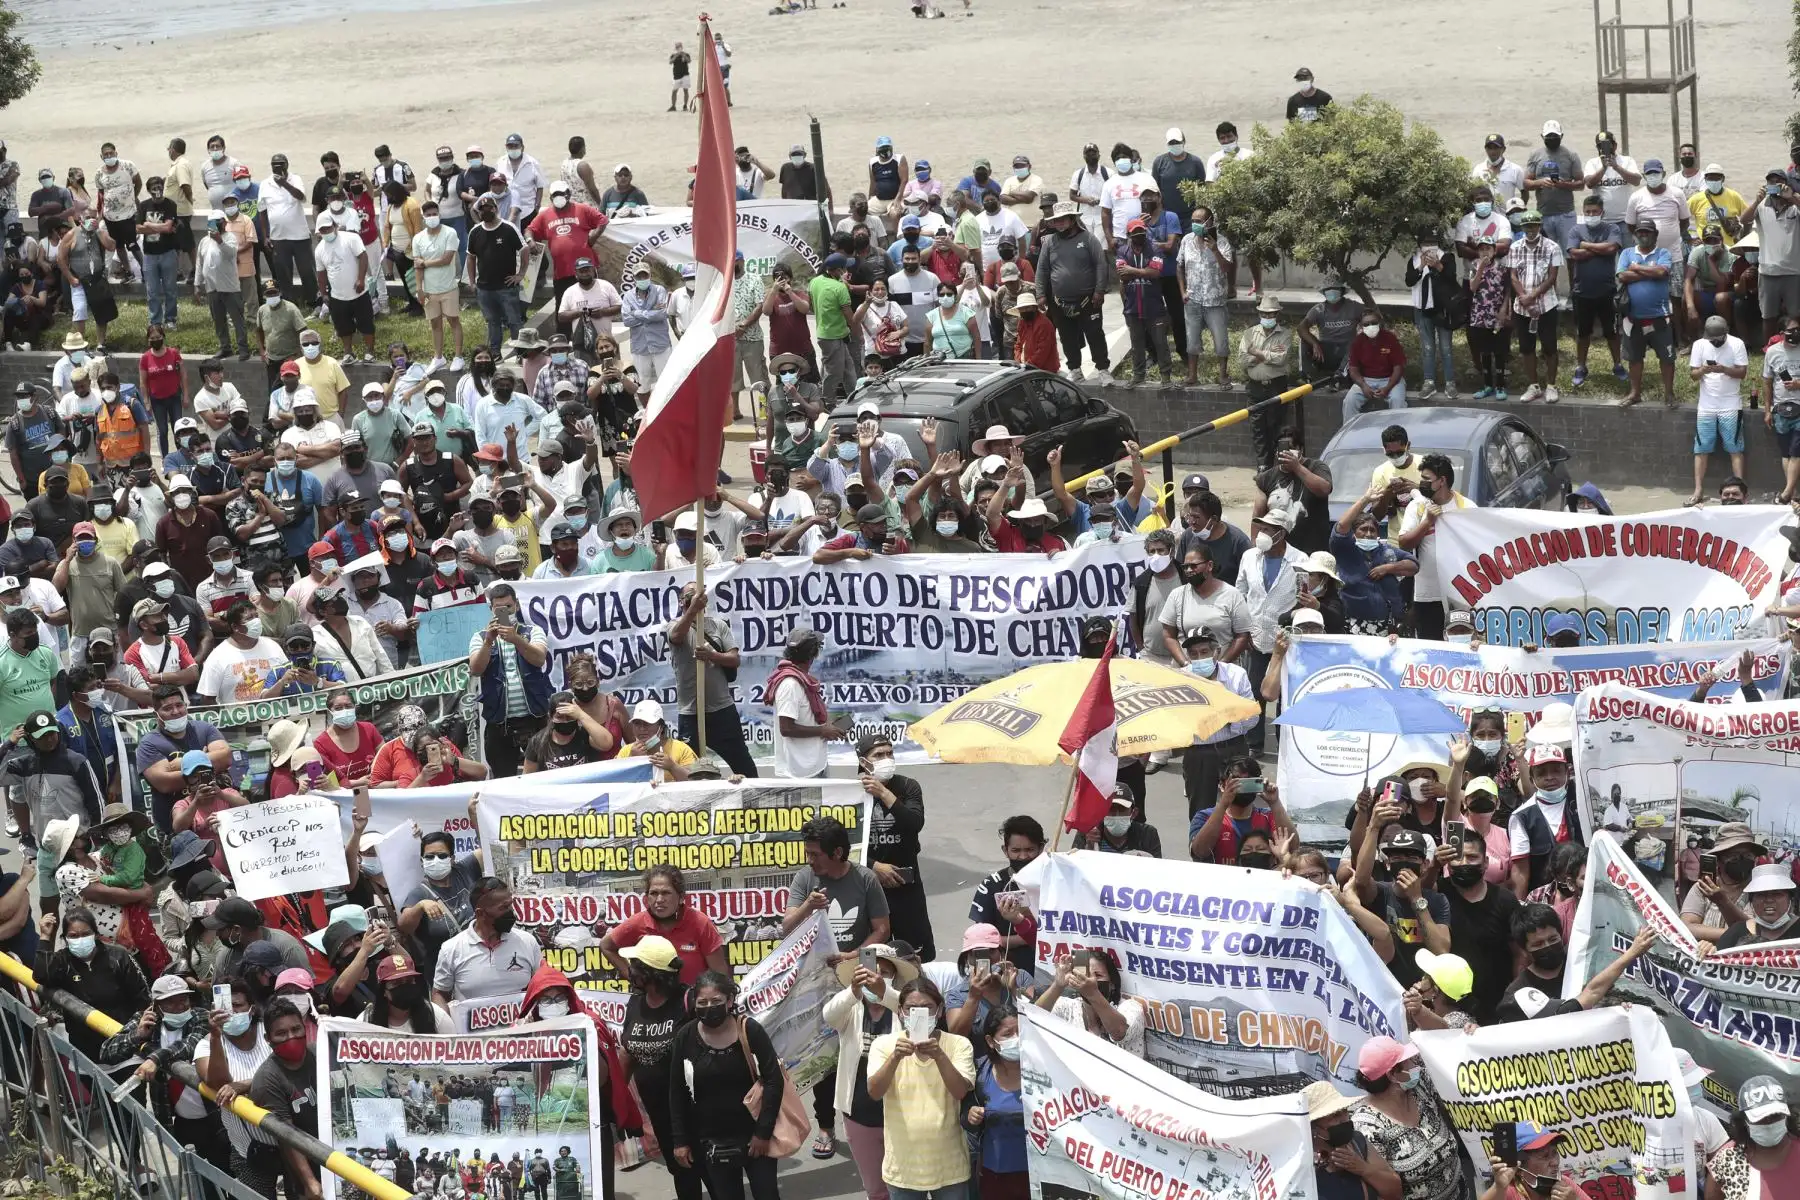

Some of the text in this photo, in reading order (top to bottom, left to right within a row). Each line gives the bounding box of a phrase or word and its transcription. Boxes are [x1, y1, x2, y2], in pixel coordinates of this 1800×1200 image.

[650, 231, 669, 248] DE
[1451, 523, 1773, 606] ASOCIACION DE COMERCIANTES
[517, 561, 1146, 641] SOCIACIÓ SINDICATO DE PESCADOR
[812, 611, 943, 651] PUERTO
[953, 617, 998, 657] DE
[1615, 606, 1672, 646] DEL
[833, 684, 911, 704] MAYO
[1400, 654, 1781, 698] ASOCIACIÓN DE EMBARCACIES
[300, 692, 329, 714] DE
[952, 701, 1026, 734] CRISTAL
[1588, 696, 1700, 735] ASOCIACIÓN
[1128, 735, 1158, 745] BARRIO
[500, 809, 609, 841] ASOCIACIÓN
[613, 812, 637, 839] DE
[641, 811, 711, 838] SOCIOS
[714, 805, 816, 835] AFECTADOS
[531, 847, 554, 873] LA
[557, 846, 630, 873] COOPAC
[634, 843, 736, 871] CREDICOOP
[562, 894, 599, 923] NO
[1100, 884, 1320, 931] ASOCIACION DE
[1199, 929, 1221, 954] Y
[1125, 950, 1262, 989] PRESENTE
[1265, 966, 1310, 993] EN
[632, 1020, 674, 1036] BE YOUR
[1190, 1006, 1229, 1045] DE
[339, 1040, 432, 1062] ASOCIACION
[436, 1038, 484, 1061] PLAYA
[486, 1036, 582, 1061] CHORRILLOS
[1457, 1051, 1553, 1097] ASOCIACION
[1550, 1049, 1575, 1086] DE
[1572, 1121, 1604, 1153] DE
[1065, 1136, 1095, 1175] DEL
[1099, 1151, 1165, 1198] PUERTO
